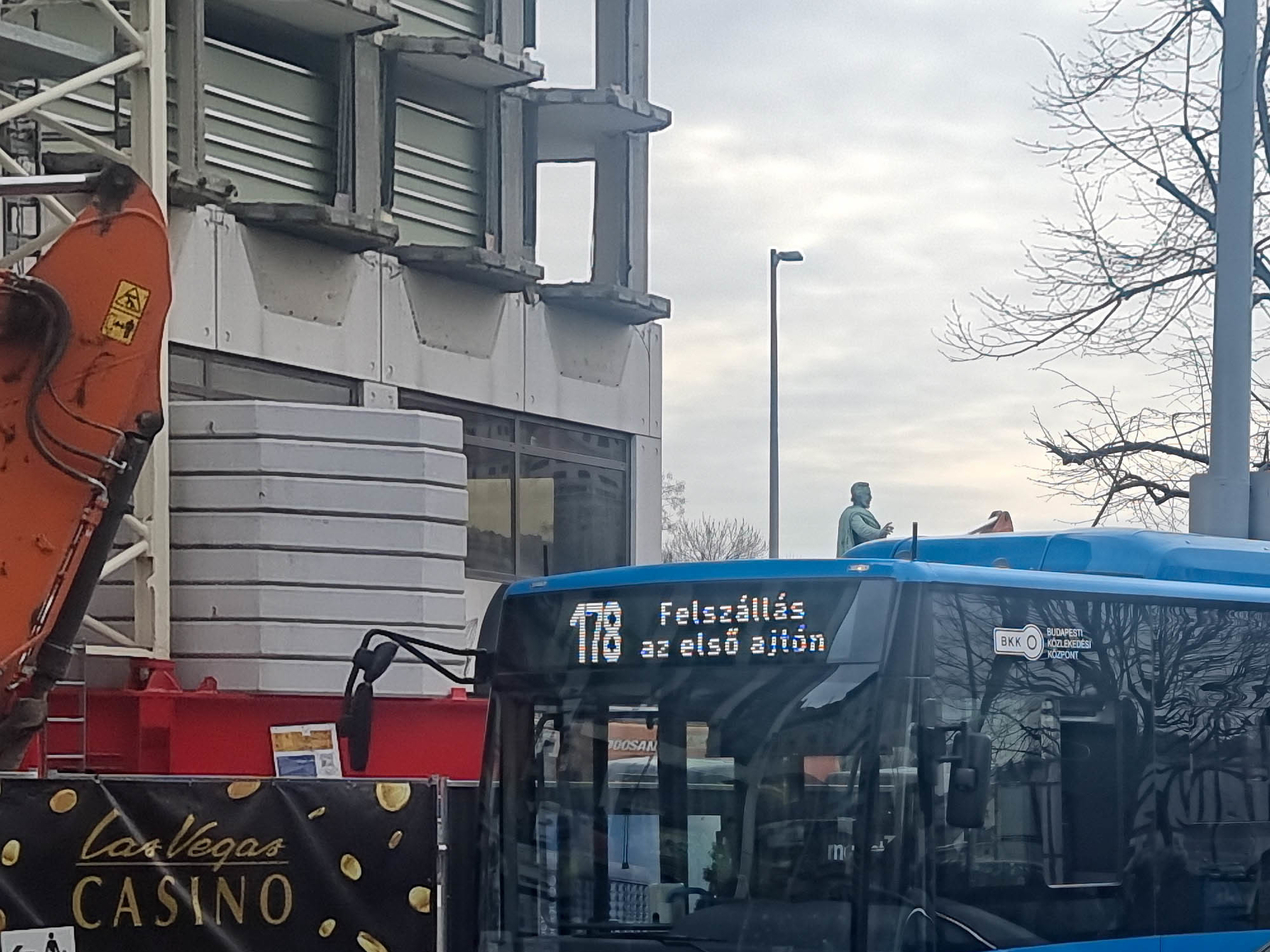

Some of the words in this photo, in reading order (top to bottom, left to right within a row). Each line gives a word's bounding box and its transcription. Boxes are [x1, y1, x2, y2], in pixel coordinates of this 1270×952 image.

[660, 592, 806, 626] Felszállás
[569, 601, 622, 664] 178
[640, 637, 670, 659] az
[680, 628, 739, 658] első
[750, 624, 826, 657] ajtón
[1001, 636, 1022, 648] BKK
[1046, 627, 1084, 637] BUDAPESTI
[81, 808, 162, 860] Las
[166, 813, 285, 872] Vegas
[72, 874, 293, 930] CASINO
